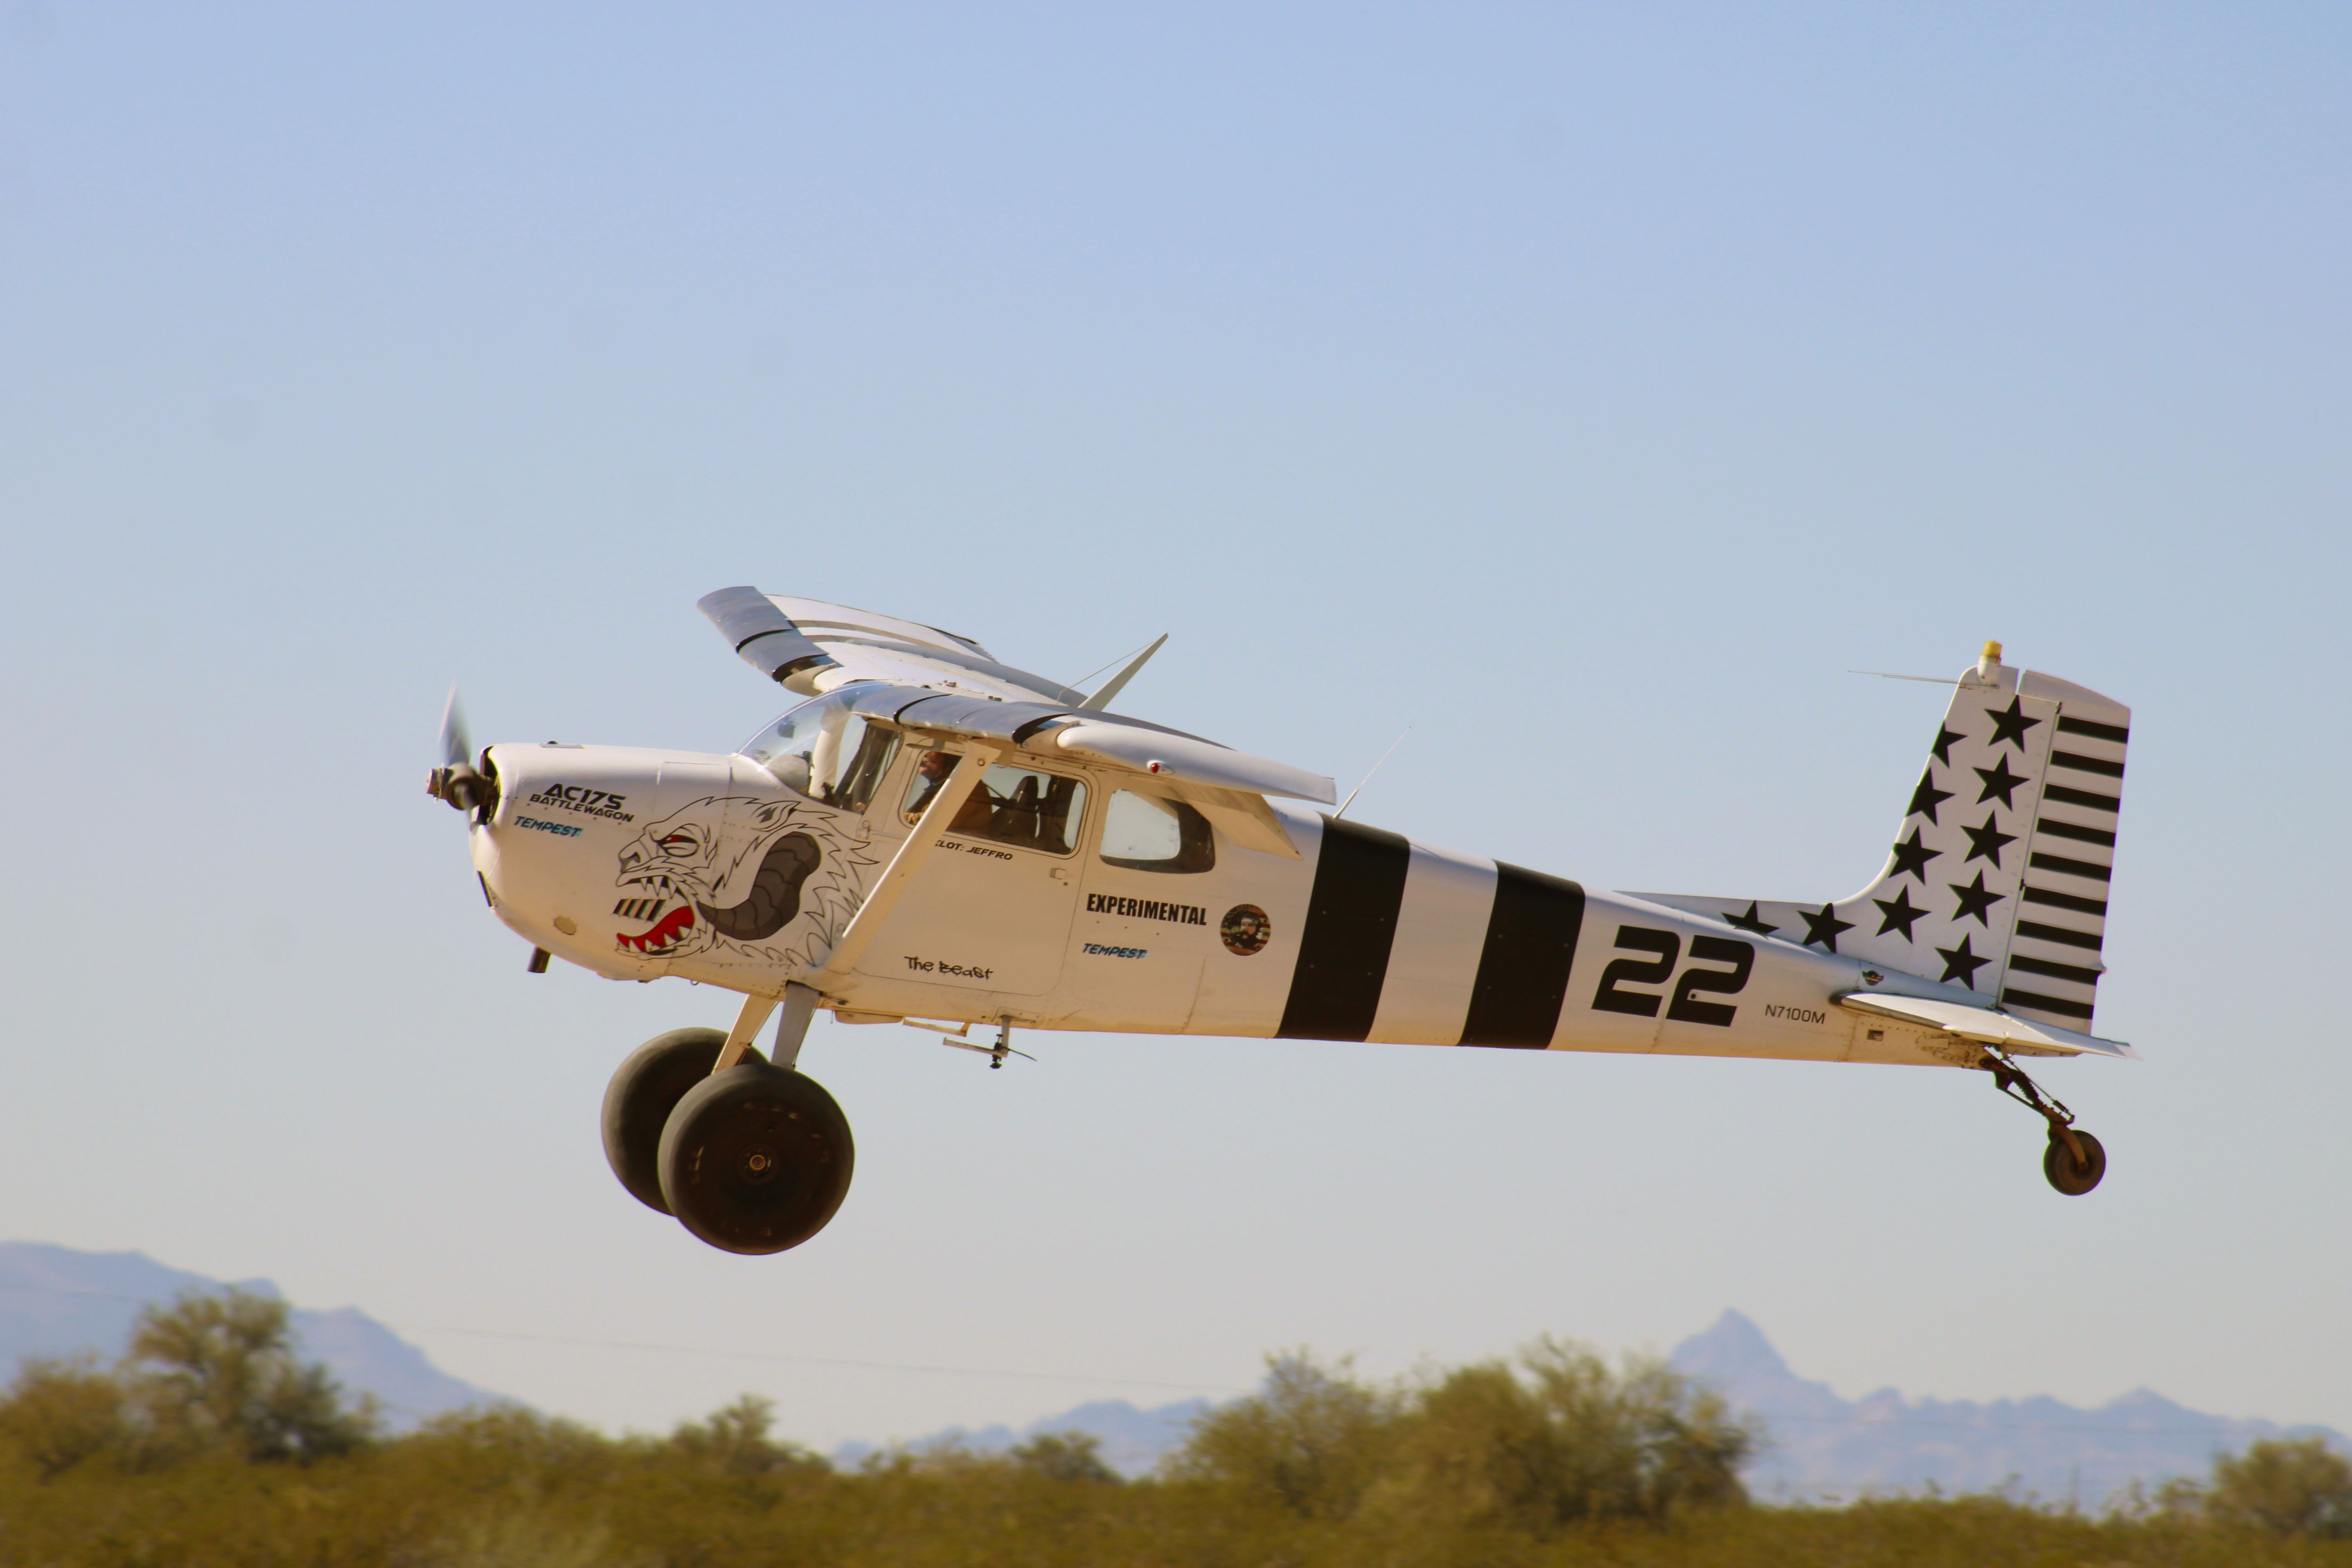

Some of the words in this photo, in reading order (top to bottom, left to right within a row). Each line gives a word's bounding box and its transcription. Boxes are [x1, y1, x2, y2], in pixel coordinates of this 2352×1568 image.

[544, 783, 627, 810] AC175
[529, 793, 634, 822] BATTLEWAGON
[514, 816, 583, 837] TEMPEST
[966, 846, 1013, 860] JEFFRO
[1086, 893, 1207, 926] EXPERIMENTAL
[1082, 943, 1147, 959] TEMPEST
[904, 956, 934, 972] The
[1591, 925, 1755, 1027] 22
[1765, 1004, 1825, 1024] N7100M
